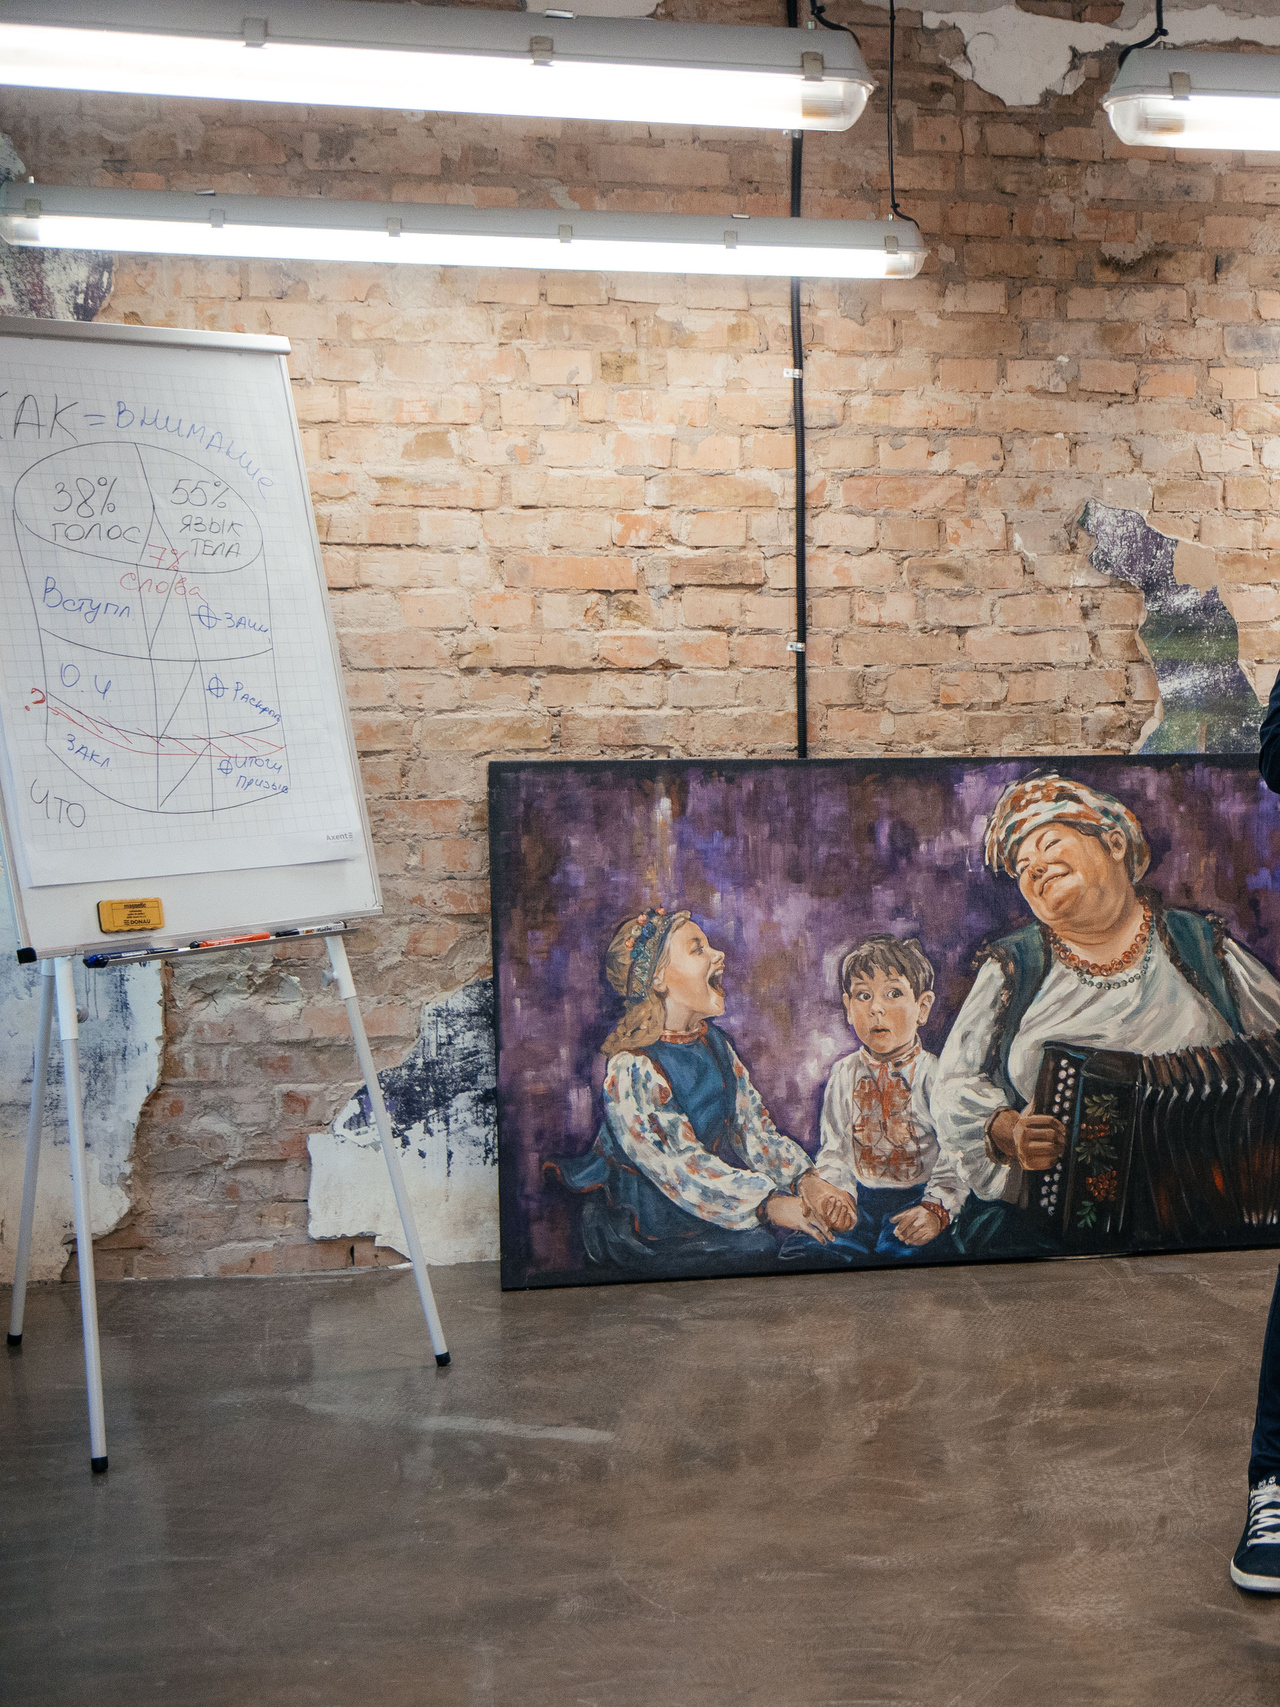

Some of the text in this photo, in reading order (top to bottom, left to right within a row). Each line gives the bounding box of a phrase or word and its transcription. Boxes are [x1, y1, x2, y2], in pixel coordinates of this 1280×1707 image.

[0, 391, 78, 442] АК
[53, 476, 117, 518] 38%
[170, 478, 229, 509] 55%
[147, 544, 189, 571] 7%
